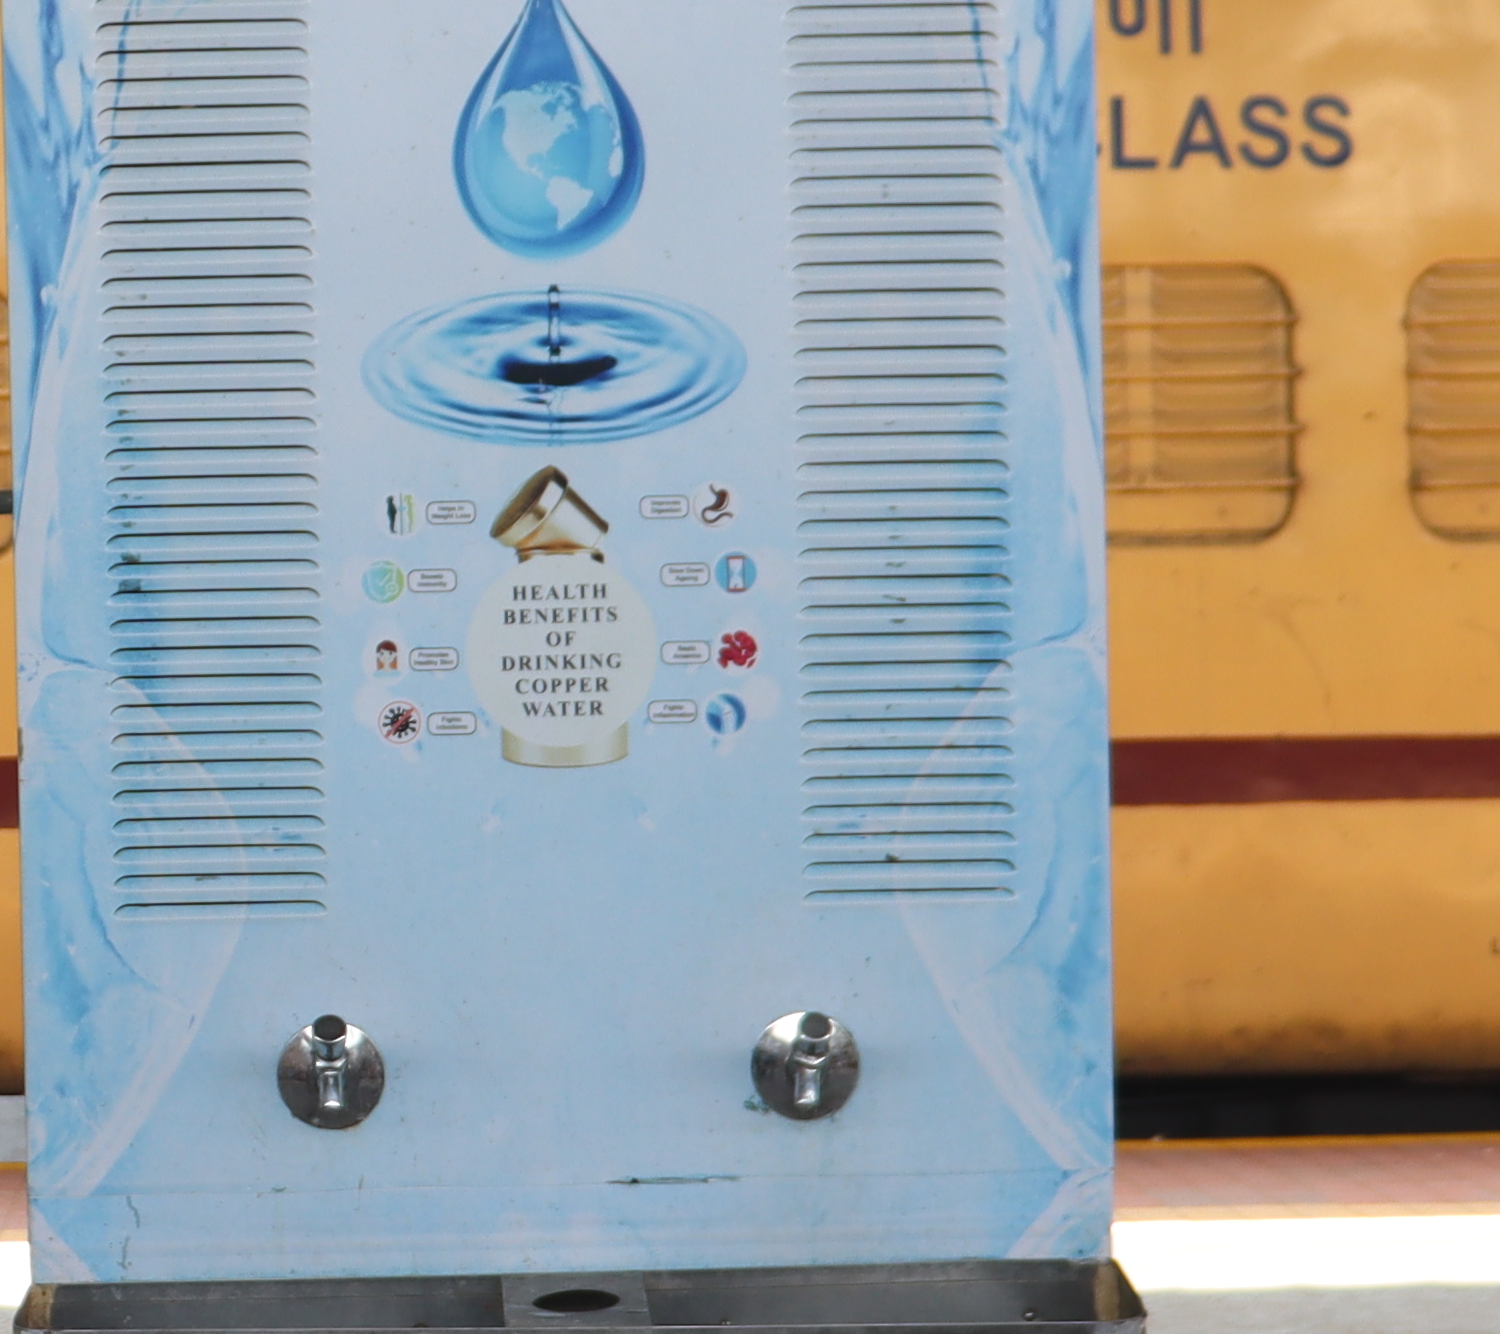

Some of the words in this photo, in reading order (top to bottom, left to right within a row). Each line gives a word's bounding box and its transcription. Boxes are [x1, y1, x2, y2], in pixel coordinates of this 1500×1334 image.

[1097, 95, 1354, 169] LASS
[512, 583, 607, 601] HEALTH
[502, 606, 619, 625] BENEFITS
[545, 630, 577, 648] OF
[500, 652, 622, 672] DRINKING
[514, 677, 610, 694] COPPER
[521, 700, 604, 717] WATER
